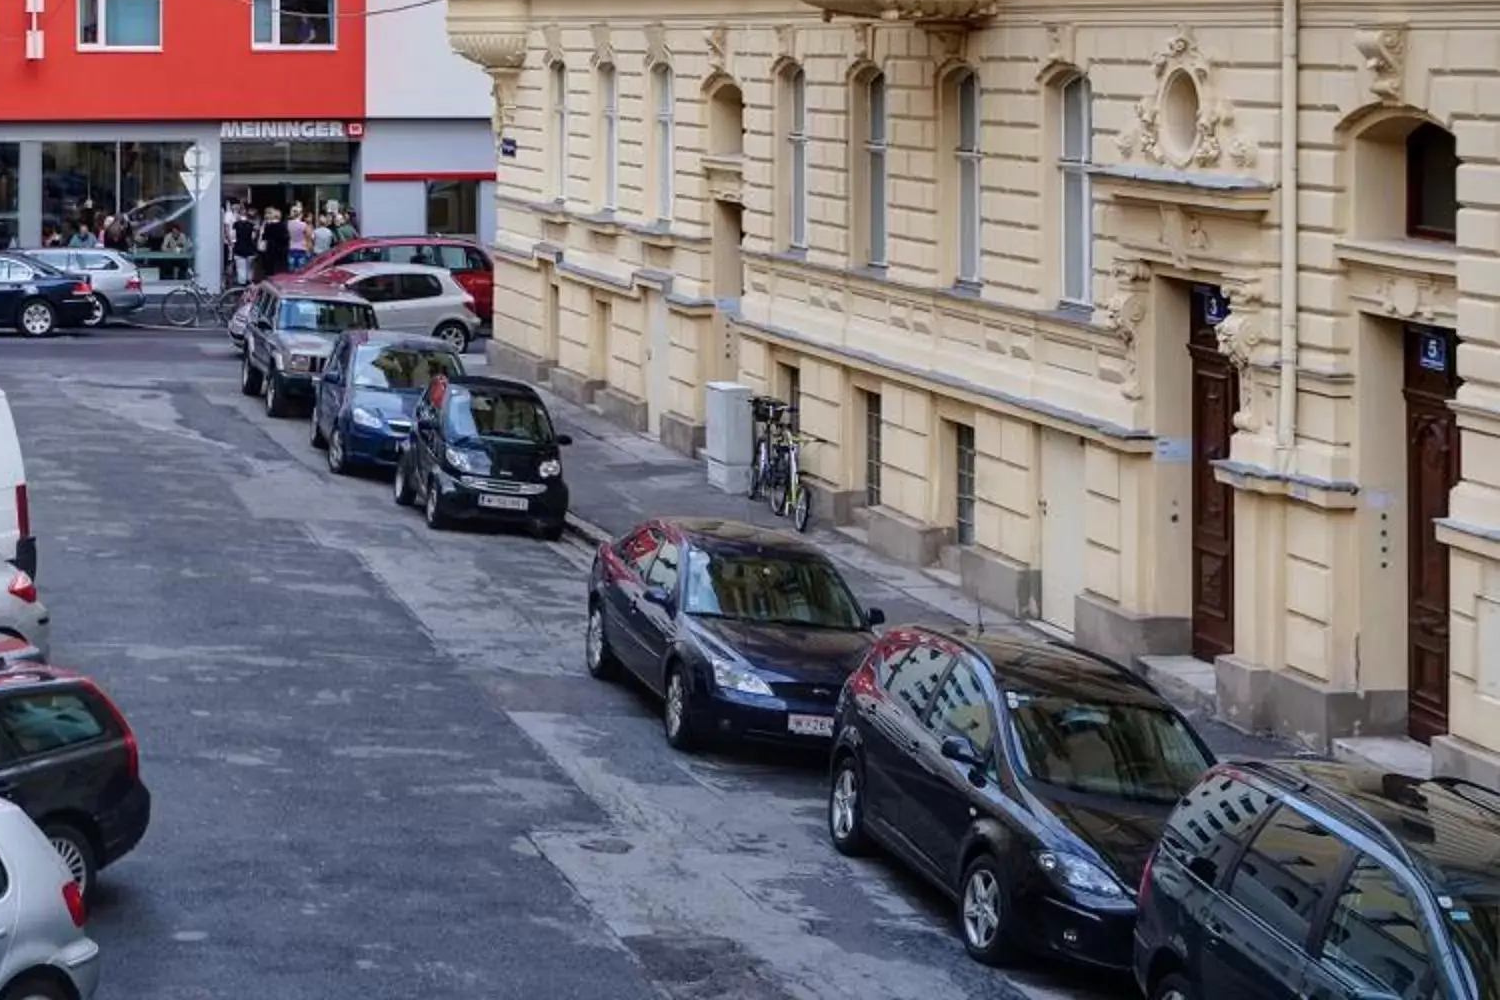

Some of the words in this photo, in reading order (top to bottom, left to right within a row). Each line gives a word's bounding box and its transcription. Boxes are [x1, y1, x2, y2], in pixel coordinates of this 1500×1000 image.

[220, 121, 344, 137] MEININGER
[1210, 297, 1217, 315] 3
[1427, 339, 1437, 358] 5
